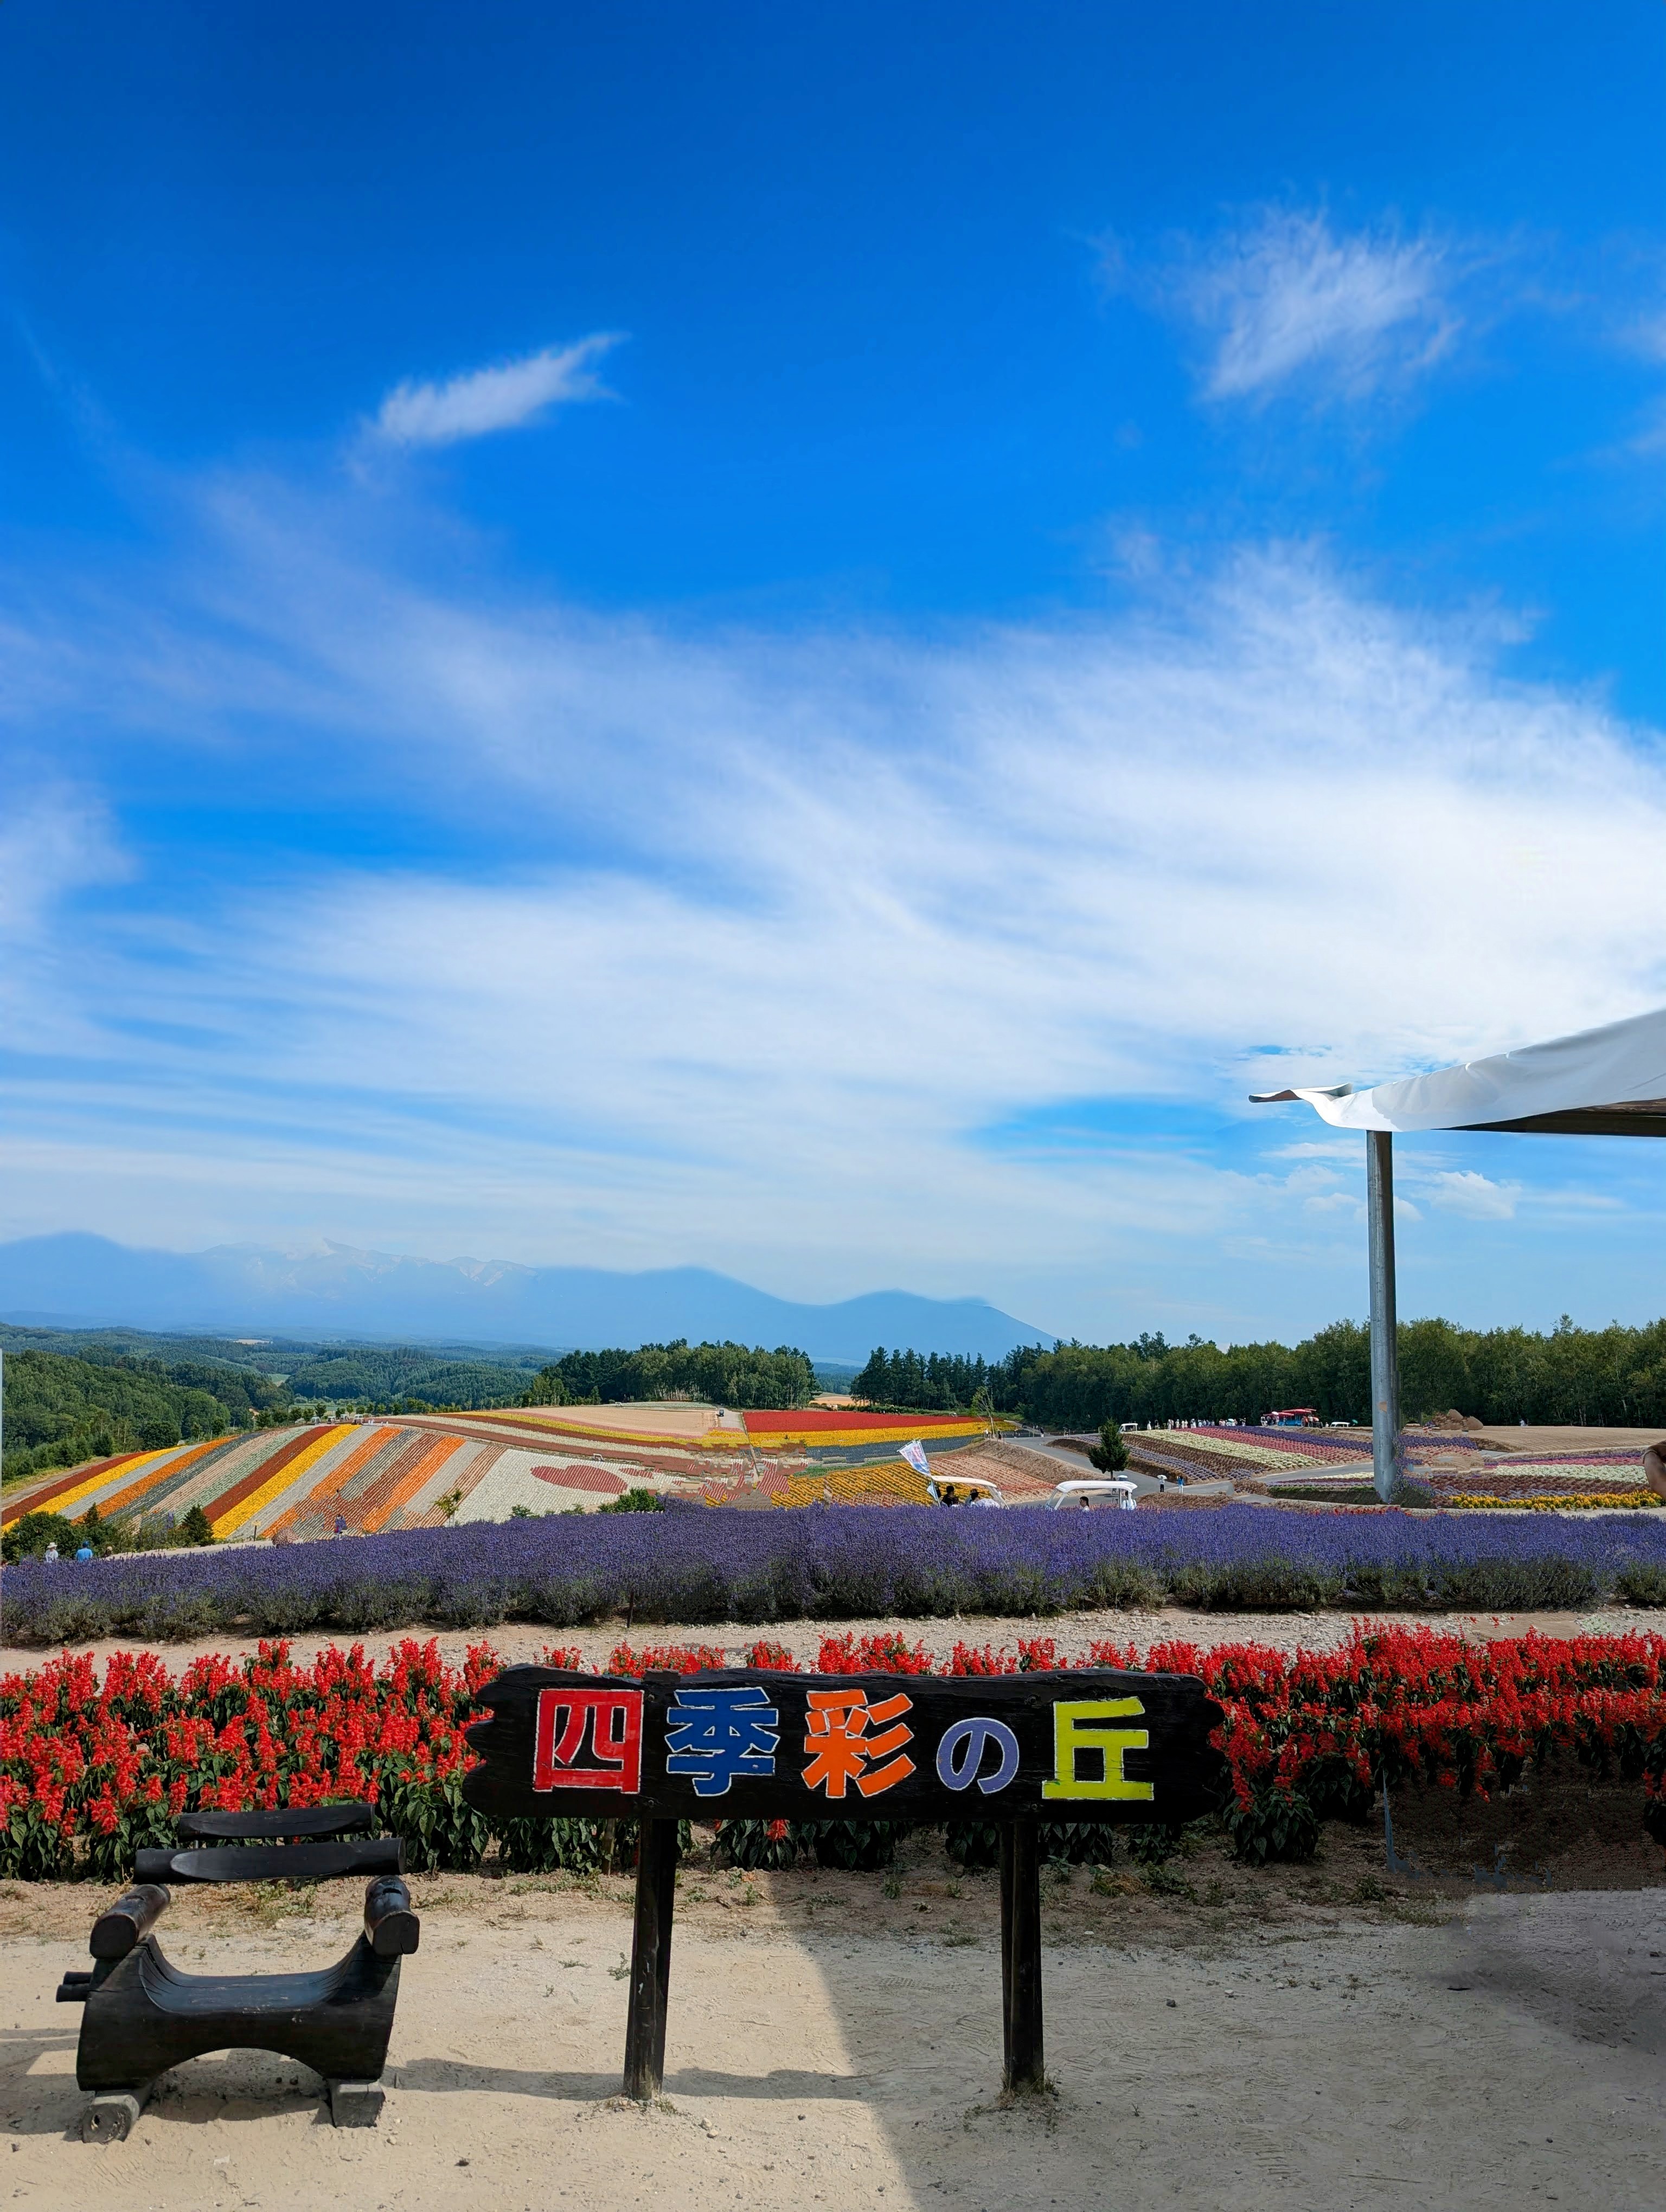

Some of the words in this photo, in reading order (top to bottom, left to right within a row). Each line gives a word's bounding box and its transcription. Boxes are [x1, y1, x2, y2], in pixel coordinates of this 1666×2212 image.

[531, 1686, 1155, 1801] 四季彩の丘
